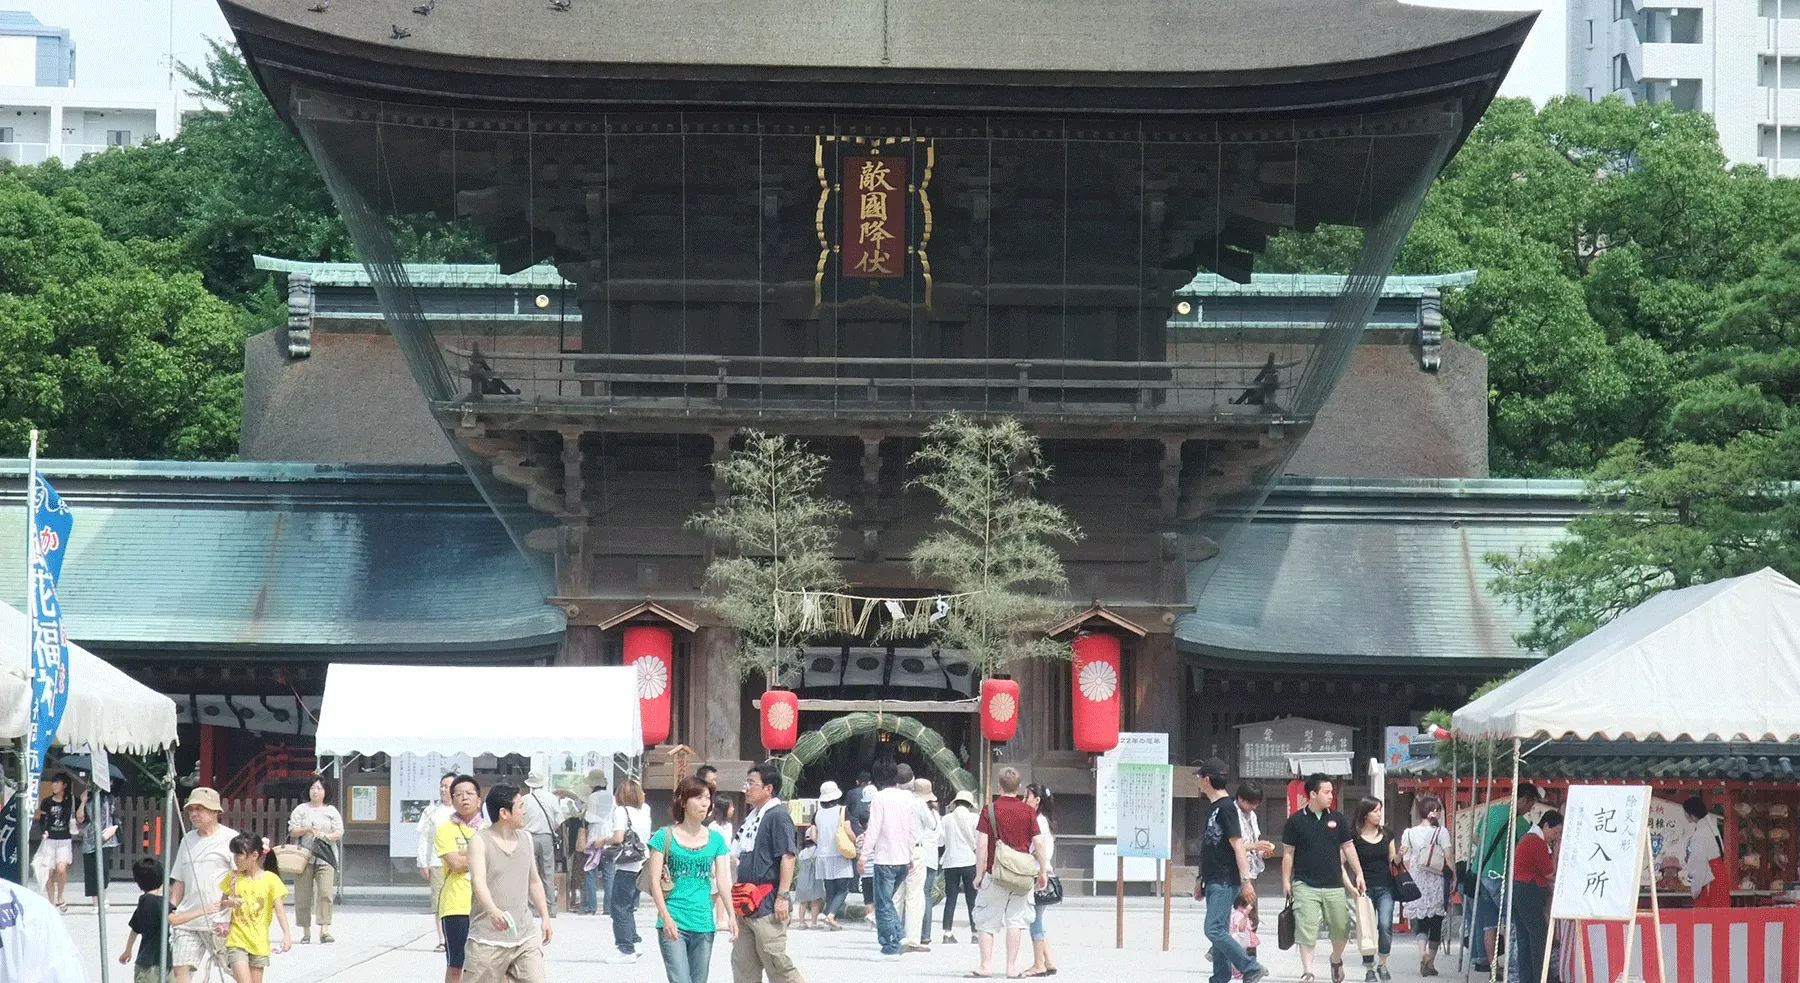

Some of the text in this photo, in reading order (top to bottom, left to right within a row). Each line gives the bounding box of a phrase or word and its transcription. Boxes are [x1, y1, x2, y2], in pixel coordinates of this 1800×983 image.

[1582, 807, 1617, 898] 記入所
[1620, 795, 1637, 850] 除災人形
